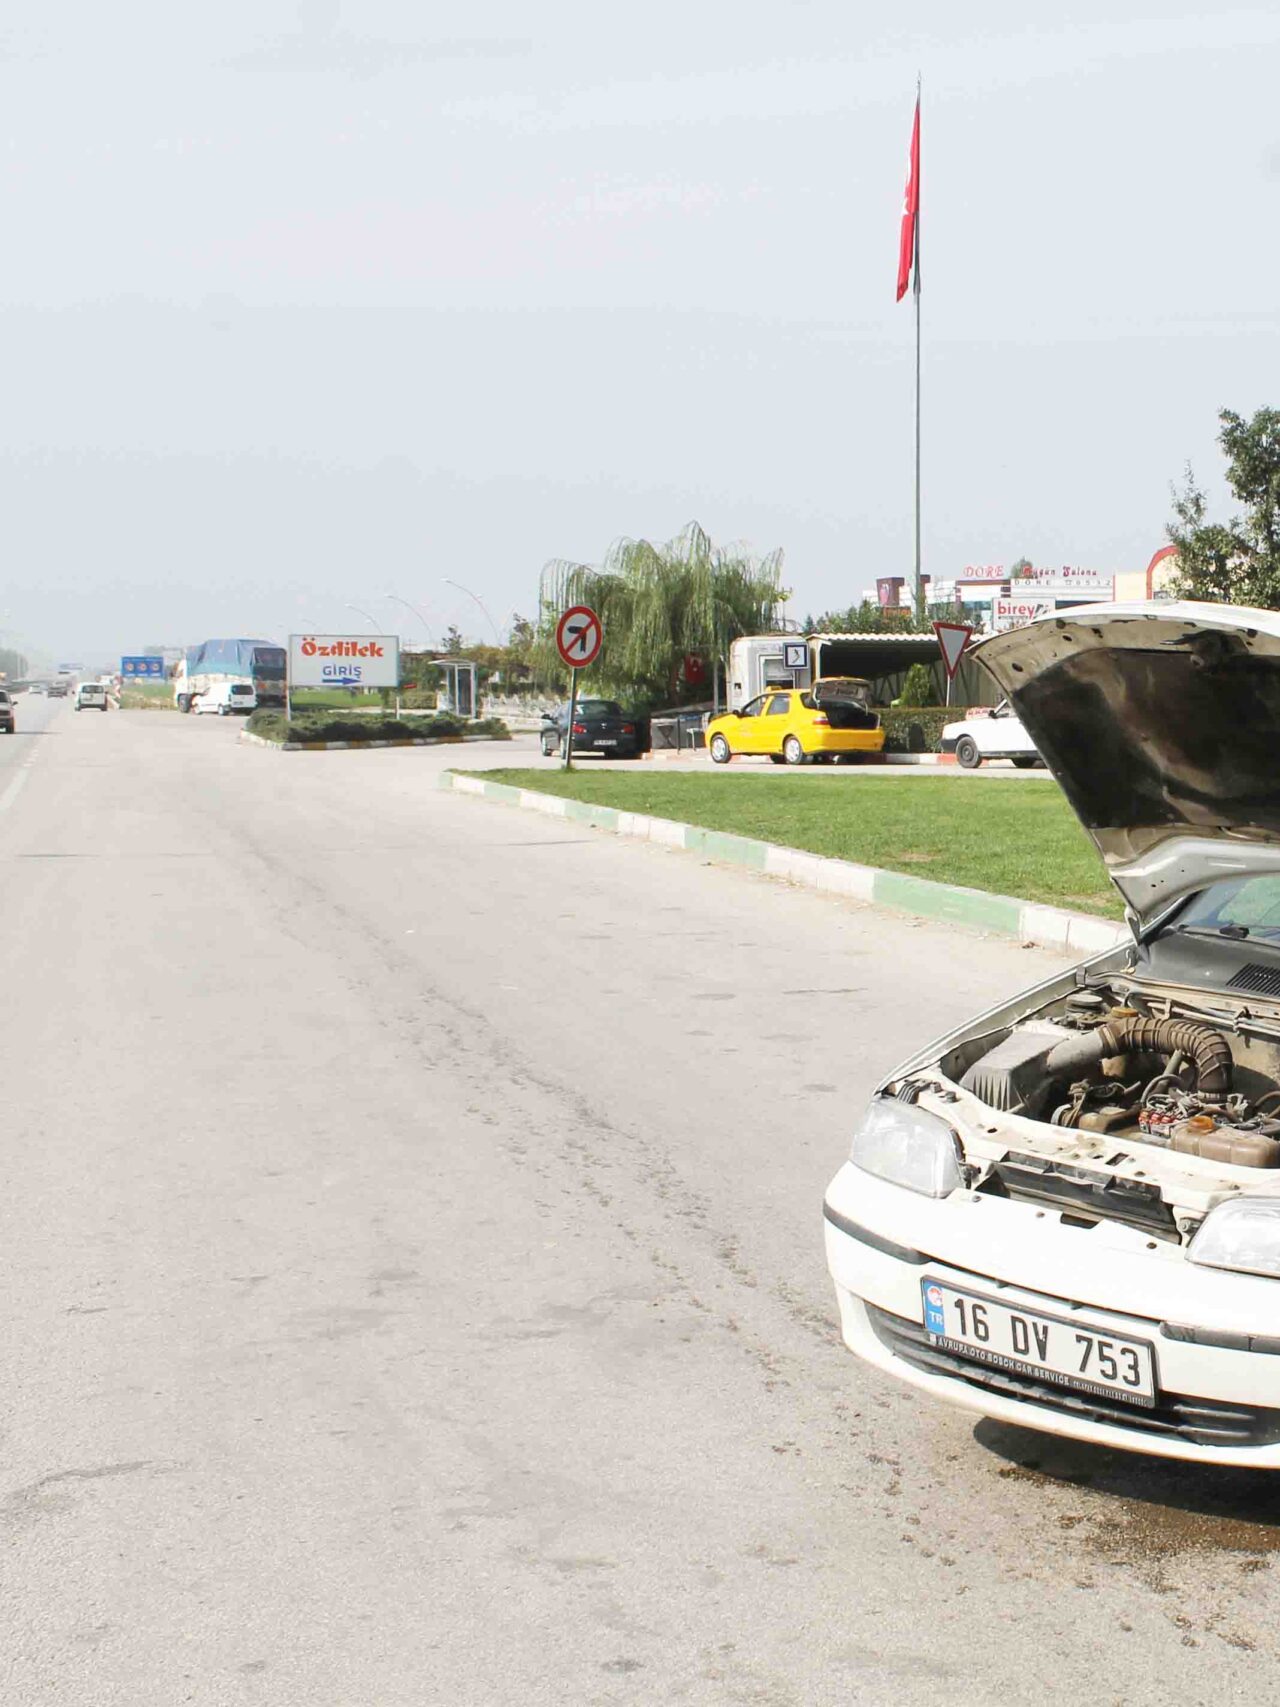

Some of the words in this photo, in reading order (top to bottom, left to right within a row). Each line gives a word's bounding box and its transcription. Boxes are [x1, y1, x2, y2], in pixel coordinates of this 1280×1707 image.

[998, 600, 1036, 619] birey
[301, 637, 384, 657] Özdilek
[322, 664, 362, 679] GİRİŞ
[929, 1311, 944, 1326] TR
[954, 1298, 990, 1342] 16
[1010, 1314, 1049, 1361] DV
[1075, 1334, 1141, 1387] 753
[937, 1336, 969, 1355] AVRUPA
[969, 1347, 987, 1361] OTO
[987, 1353, 1015, 1369] BOSCH
[1015, 1362, 1034, 1376] CAR
[1033, 1367, 1070, 1386] SERVICE
